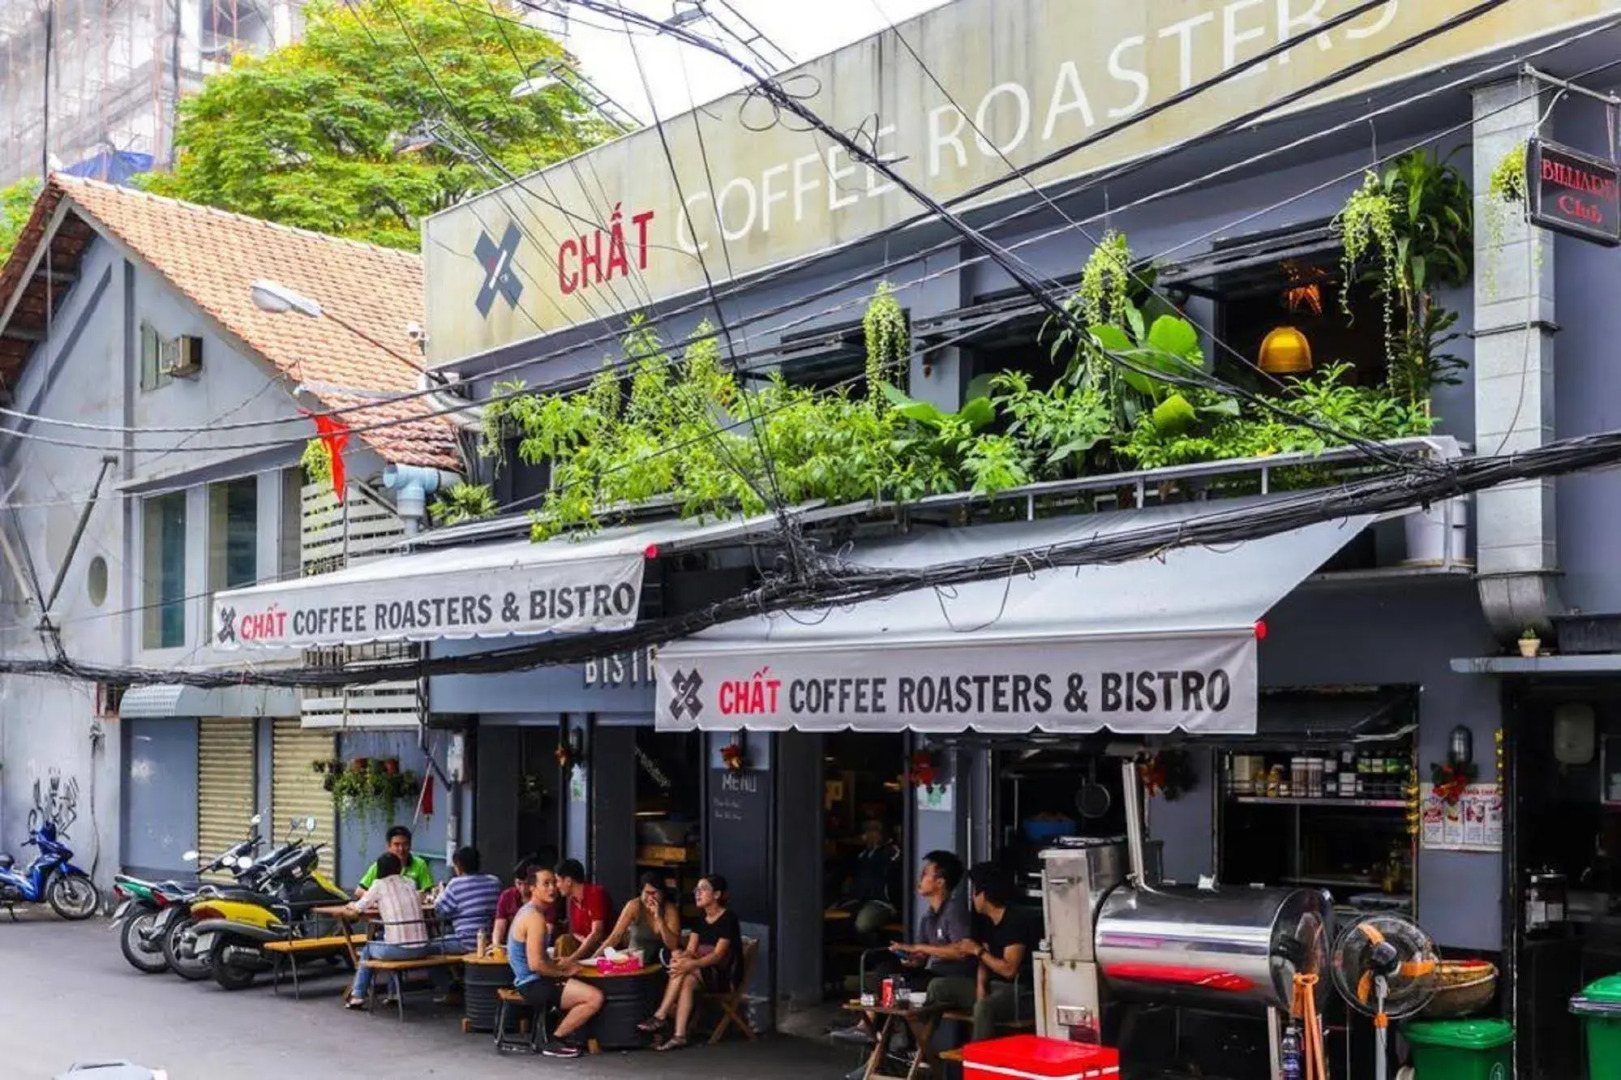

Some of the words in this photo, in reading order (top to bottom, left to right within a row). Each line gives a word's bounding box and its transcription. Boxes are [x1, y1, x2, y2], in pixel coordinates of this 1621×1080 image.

[559, 202, 654, 295] CHẤT
[677, 124, 898, 255] COFFEE
[240, 603, 287, 640] CHẤT
[293, 605, 367, 636] COFFEE
[375, 594, 492, 631] ROASTERS
[501, 592, 520, 622] &
[529, 582, 636, 621] BISTRO
[719, 666, 781, 715] CHẤT
[789, 678, 887, 713] COFFEE
[898, 675, 1052, 713] ROASTERS
[1063, 673, 1088, 713] &
[1101, 669, 1231, 712] BISTRO
